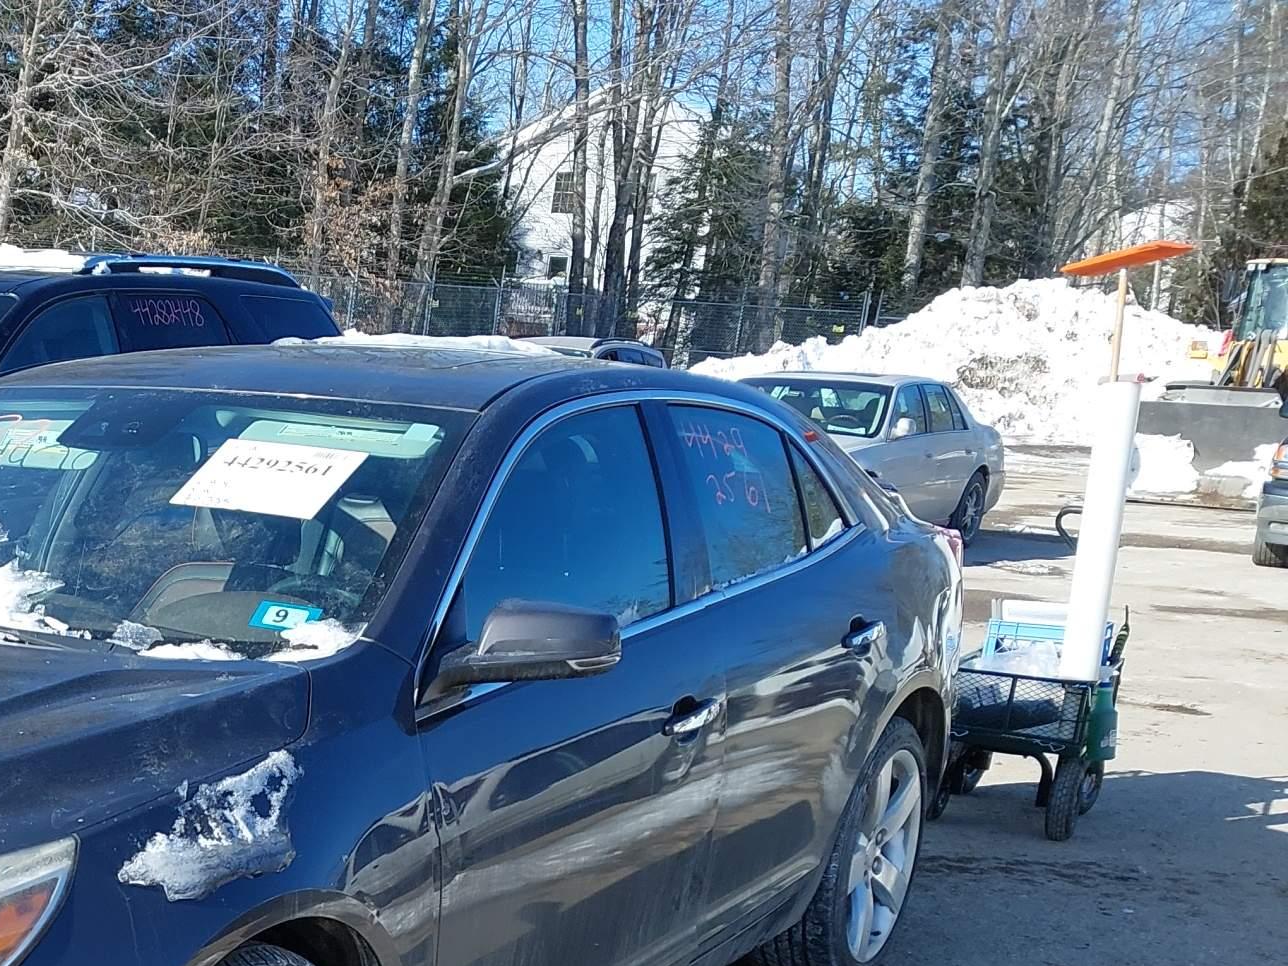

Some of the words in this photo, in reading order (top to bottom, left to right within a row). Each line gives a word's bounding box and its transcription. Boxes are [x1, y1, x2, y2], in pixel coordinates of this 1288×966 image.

[131, 299, 205, 327] 44282448
[223, 454, 334, 477] 44292561
[705, 470, 772, 514] 2561
[272, 609, 289, 624] 9
